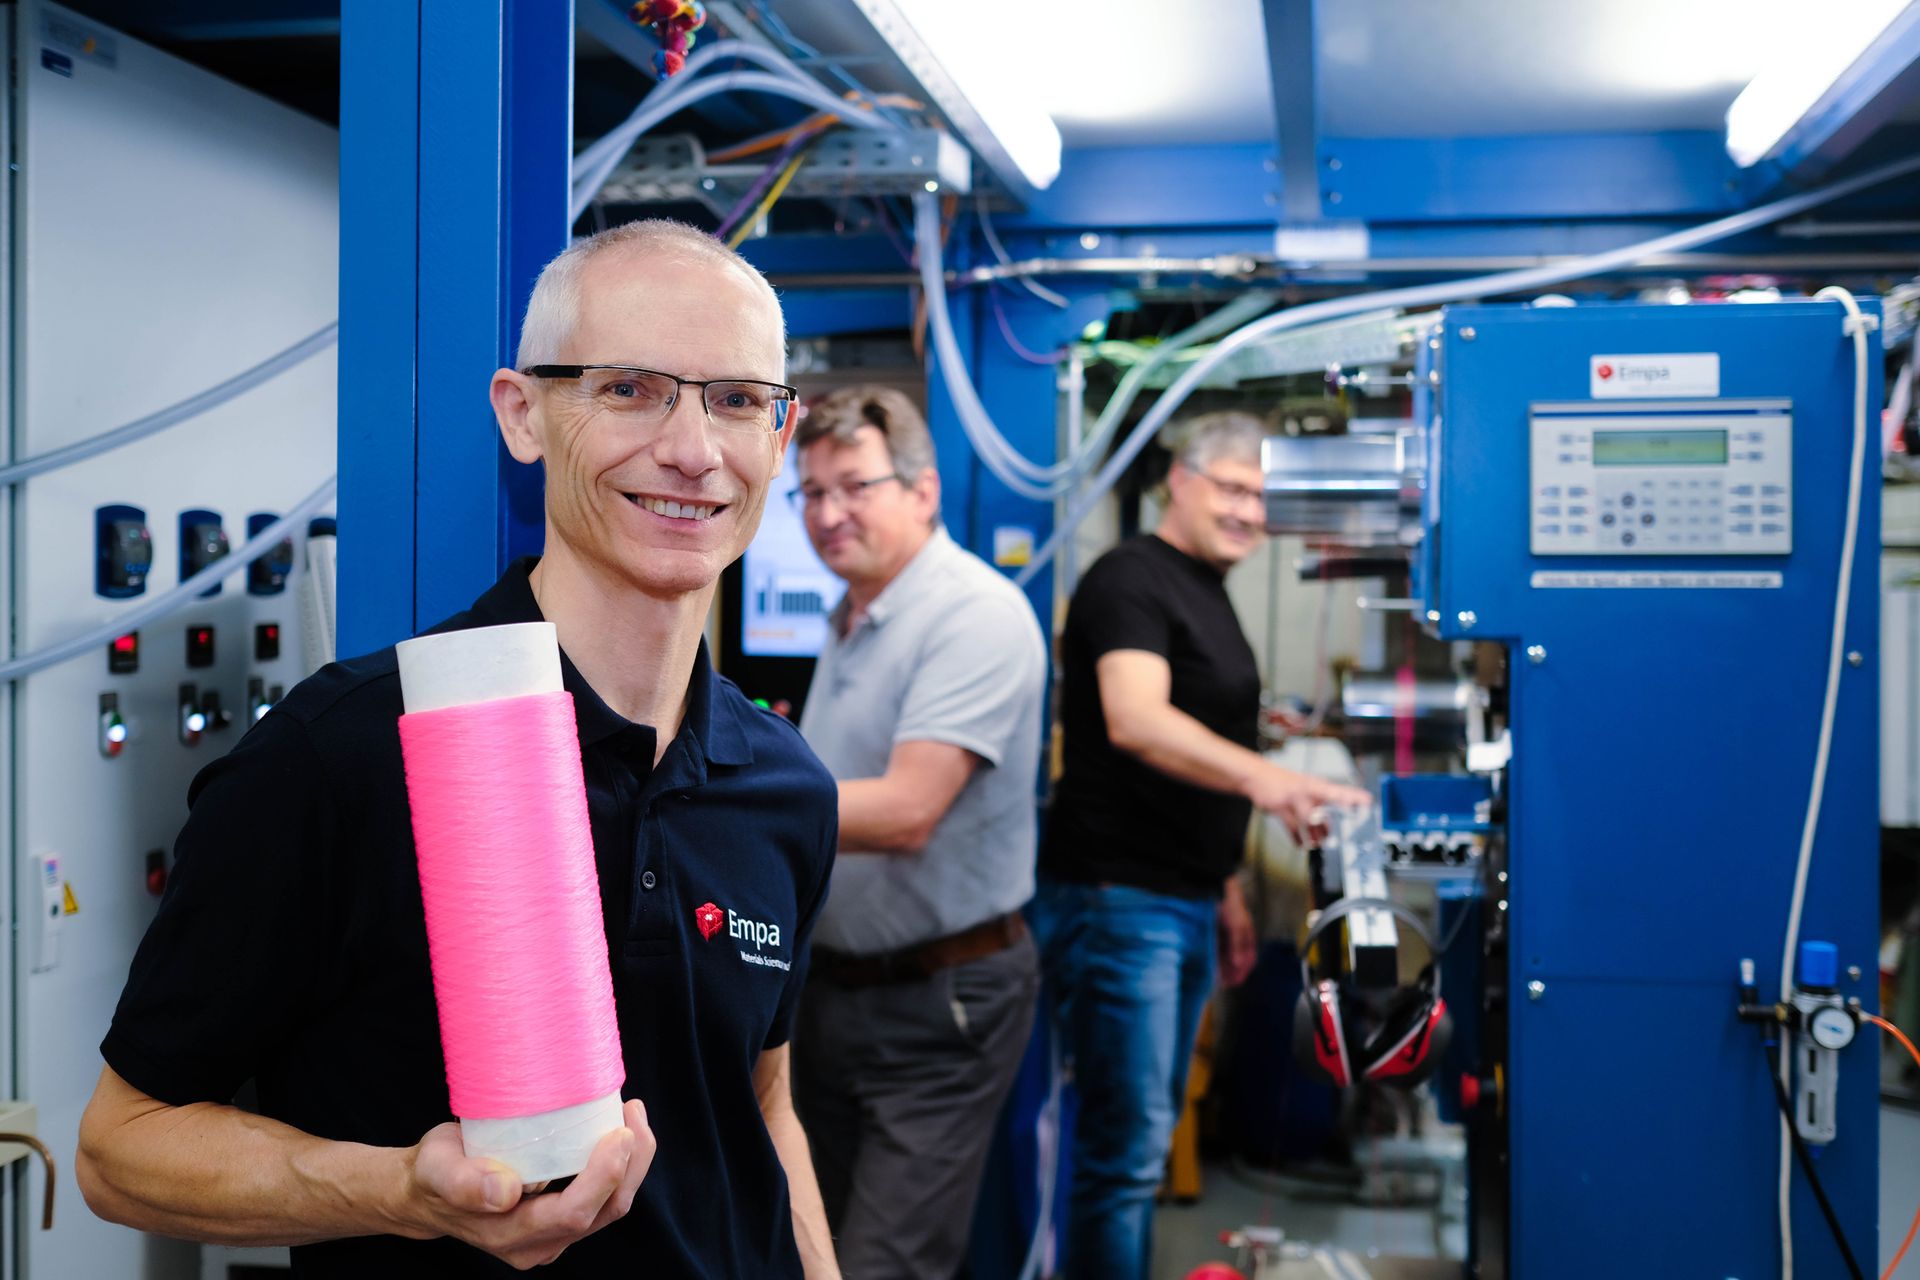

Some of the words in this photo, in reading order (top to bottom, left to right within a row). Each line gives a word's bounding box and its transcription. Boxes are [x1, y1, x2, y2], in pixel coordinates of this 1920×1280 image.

[1619, 366, 1670, 383] Empa
[728, 908, 780, 951] Empa
[740, 951, 764, 965] Materials
